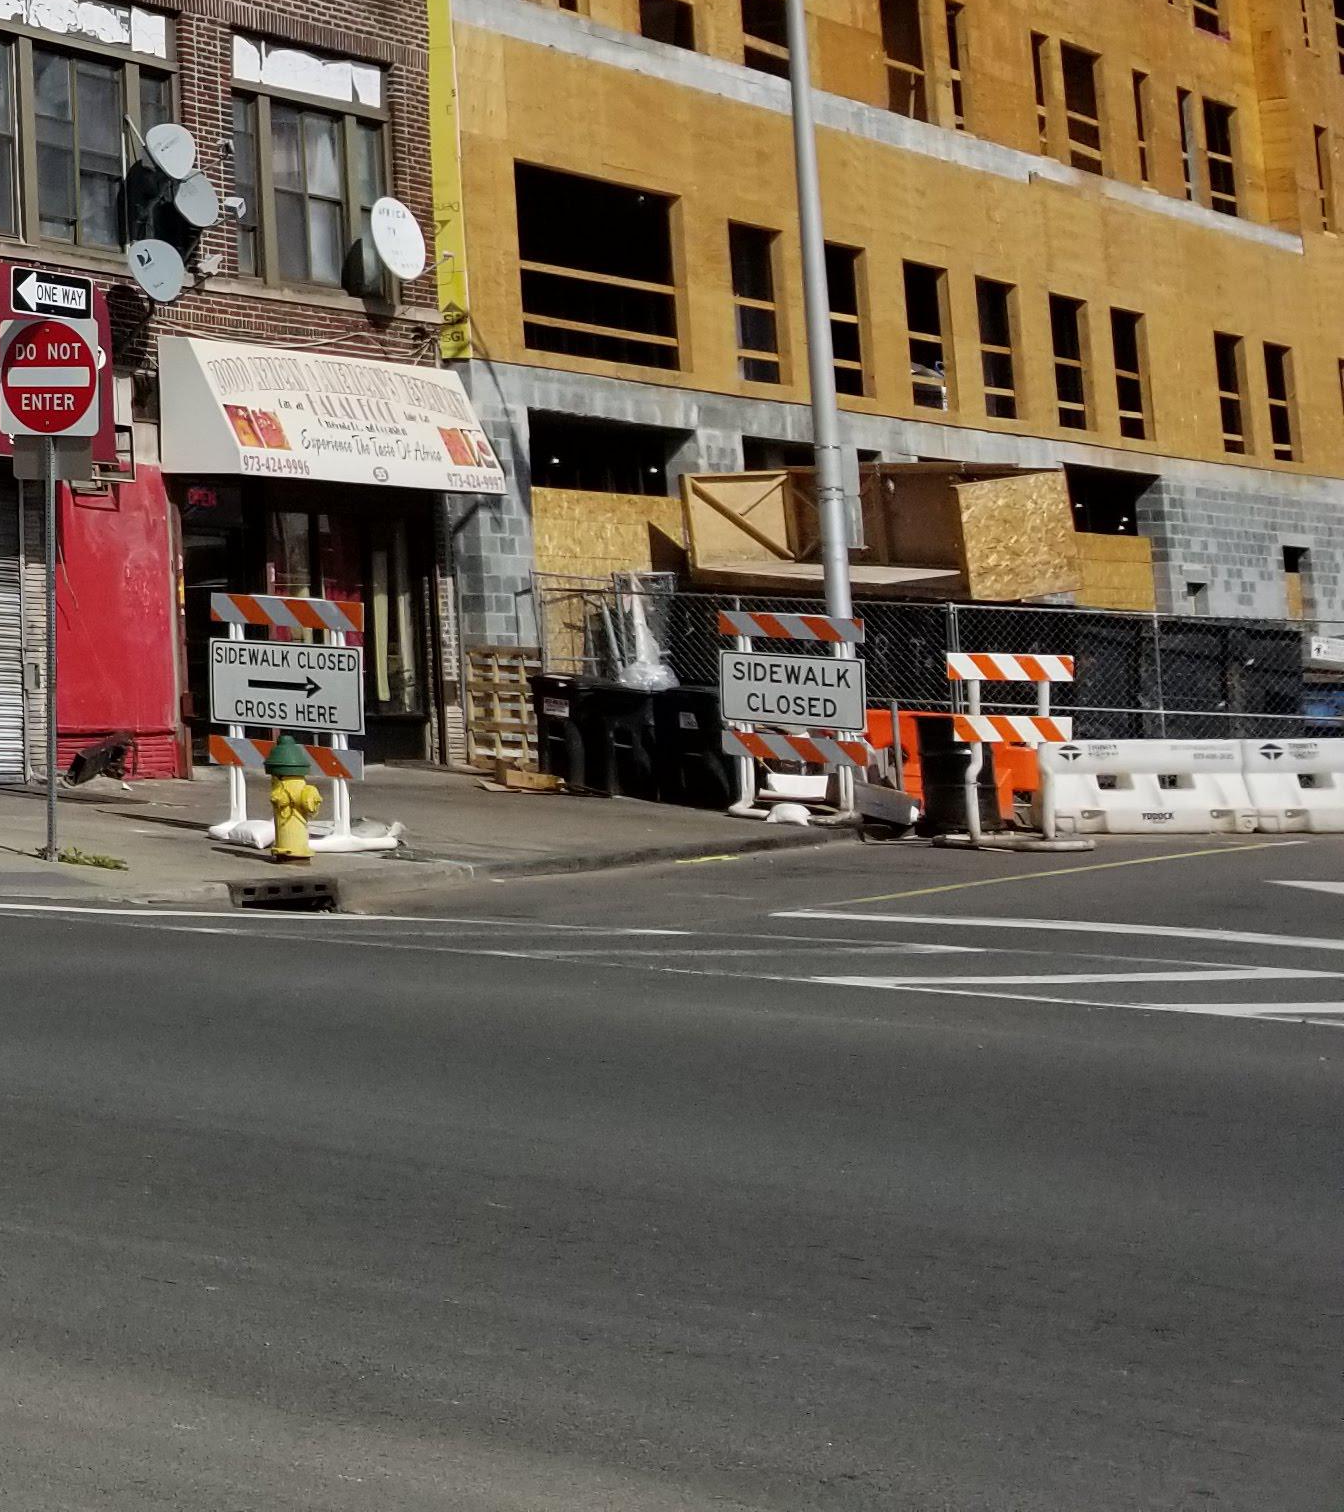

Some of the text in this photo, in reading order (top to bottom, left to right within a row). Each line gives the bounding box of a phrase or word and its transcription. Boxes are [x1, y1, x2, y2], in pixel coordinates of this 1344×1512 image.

[37, 285, 83, 306] ONE WAY
[15, 342, 82, 360] DO NOT
[21, 393, 75, 411] ENTER
[243, 455, 310, 476] 973-424-9996
[214, 646, 357, 673] SIDEWALK CLOSED
[732, 660, 851, 689] SIDEWALK
[235, 699, 339, 725] CROSS HERE
[746, 692, 838, 719] CLOSED
